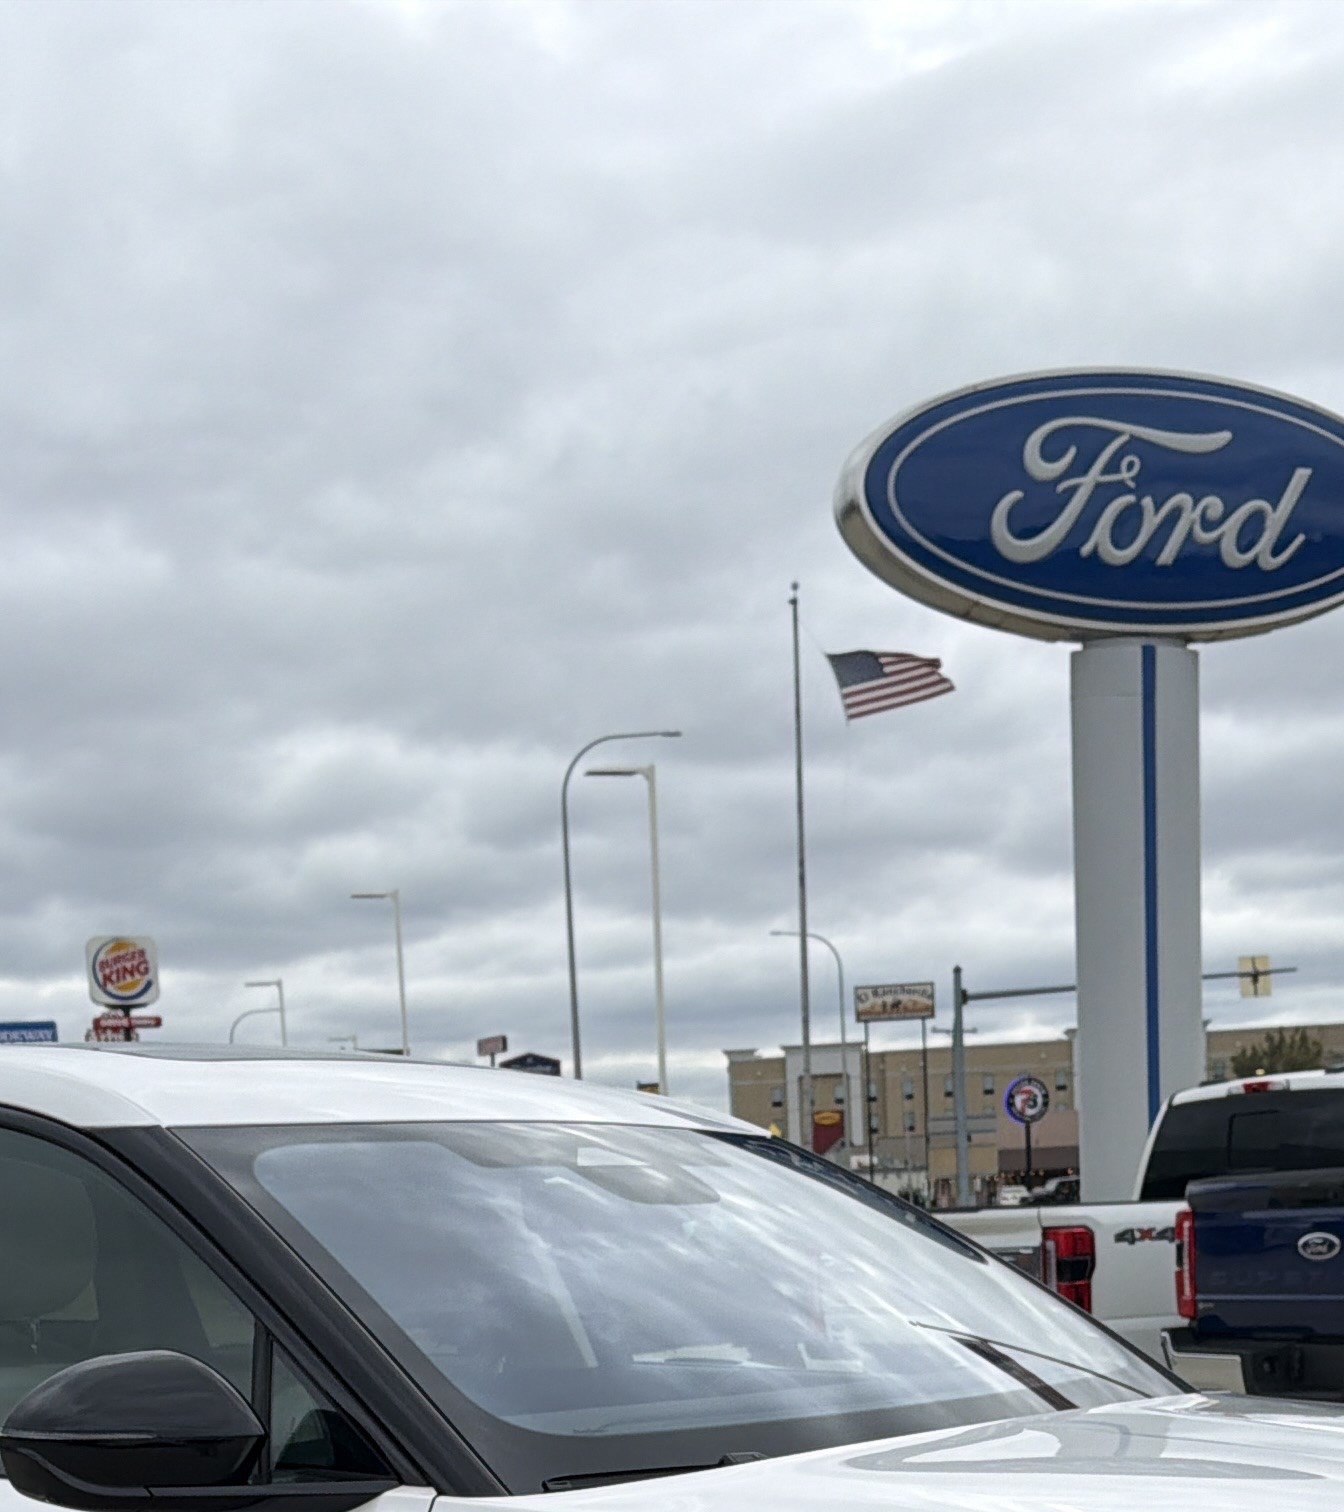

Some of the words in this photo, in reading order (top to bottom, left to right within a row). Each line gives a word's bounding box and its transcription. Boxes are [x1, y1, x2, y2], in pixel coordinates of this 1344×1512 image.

[991, 416, 1313, 571] Ford
[98, 948, 146, 973] BURGER
[101, 958, 150, 988] KING
